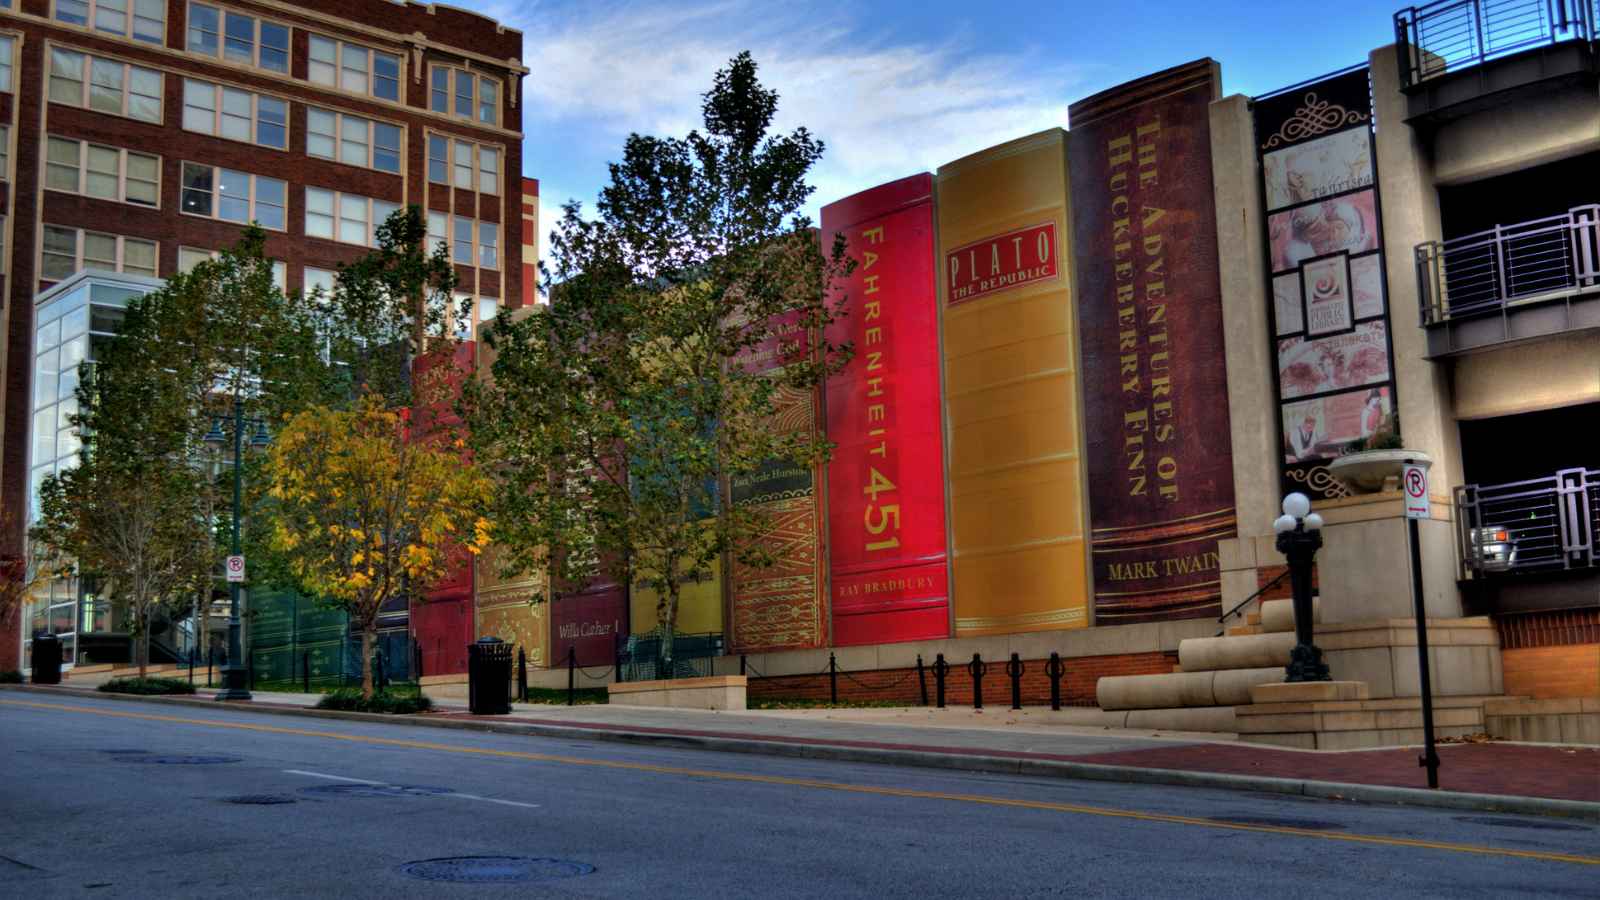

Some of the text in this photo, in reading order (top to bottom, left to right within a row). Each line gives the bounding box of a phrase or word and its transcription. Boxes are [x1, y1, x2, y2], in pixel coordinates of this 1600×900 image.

[951, 231, 1049, 289] PLATO
[952, 265, 1049, 300] THE REPUBLIC
[1108, 132, 1149, 497] HUCKLEBERRY FINN
[1136, 114, 1179, 501] THE ADVENTURES OF
[863, 225, 900, 551] FAHRENHEIT 451
[840, 575, 936, 596] RAY BRADBURY
[1108, 560, 1158, 580] MARK
